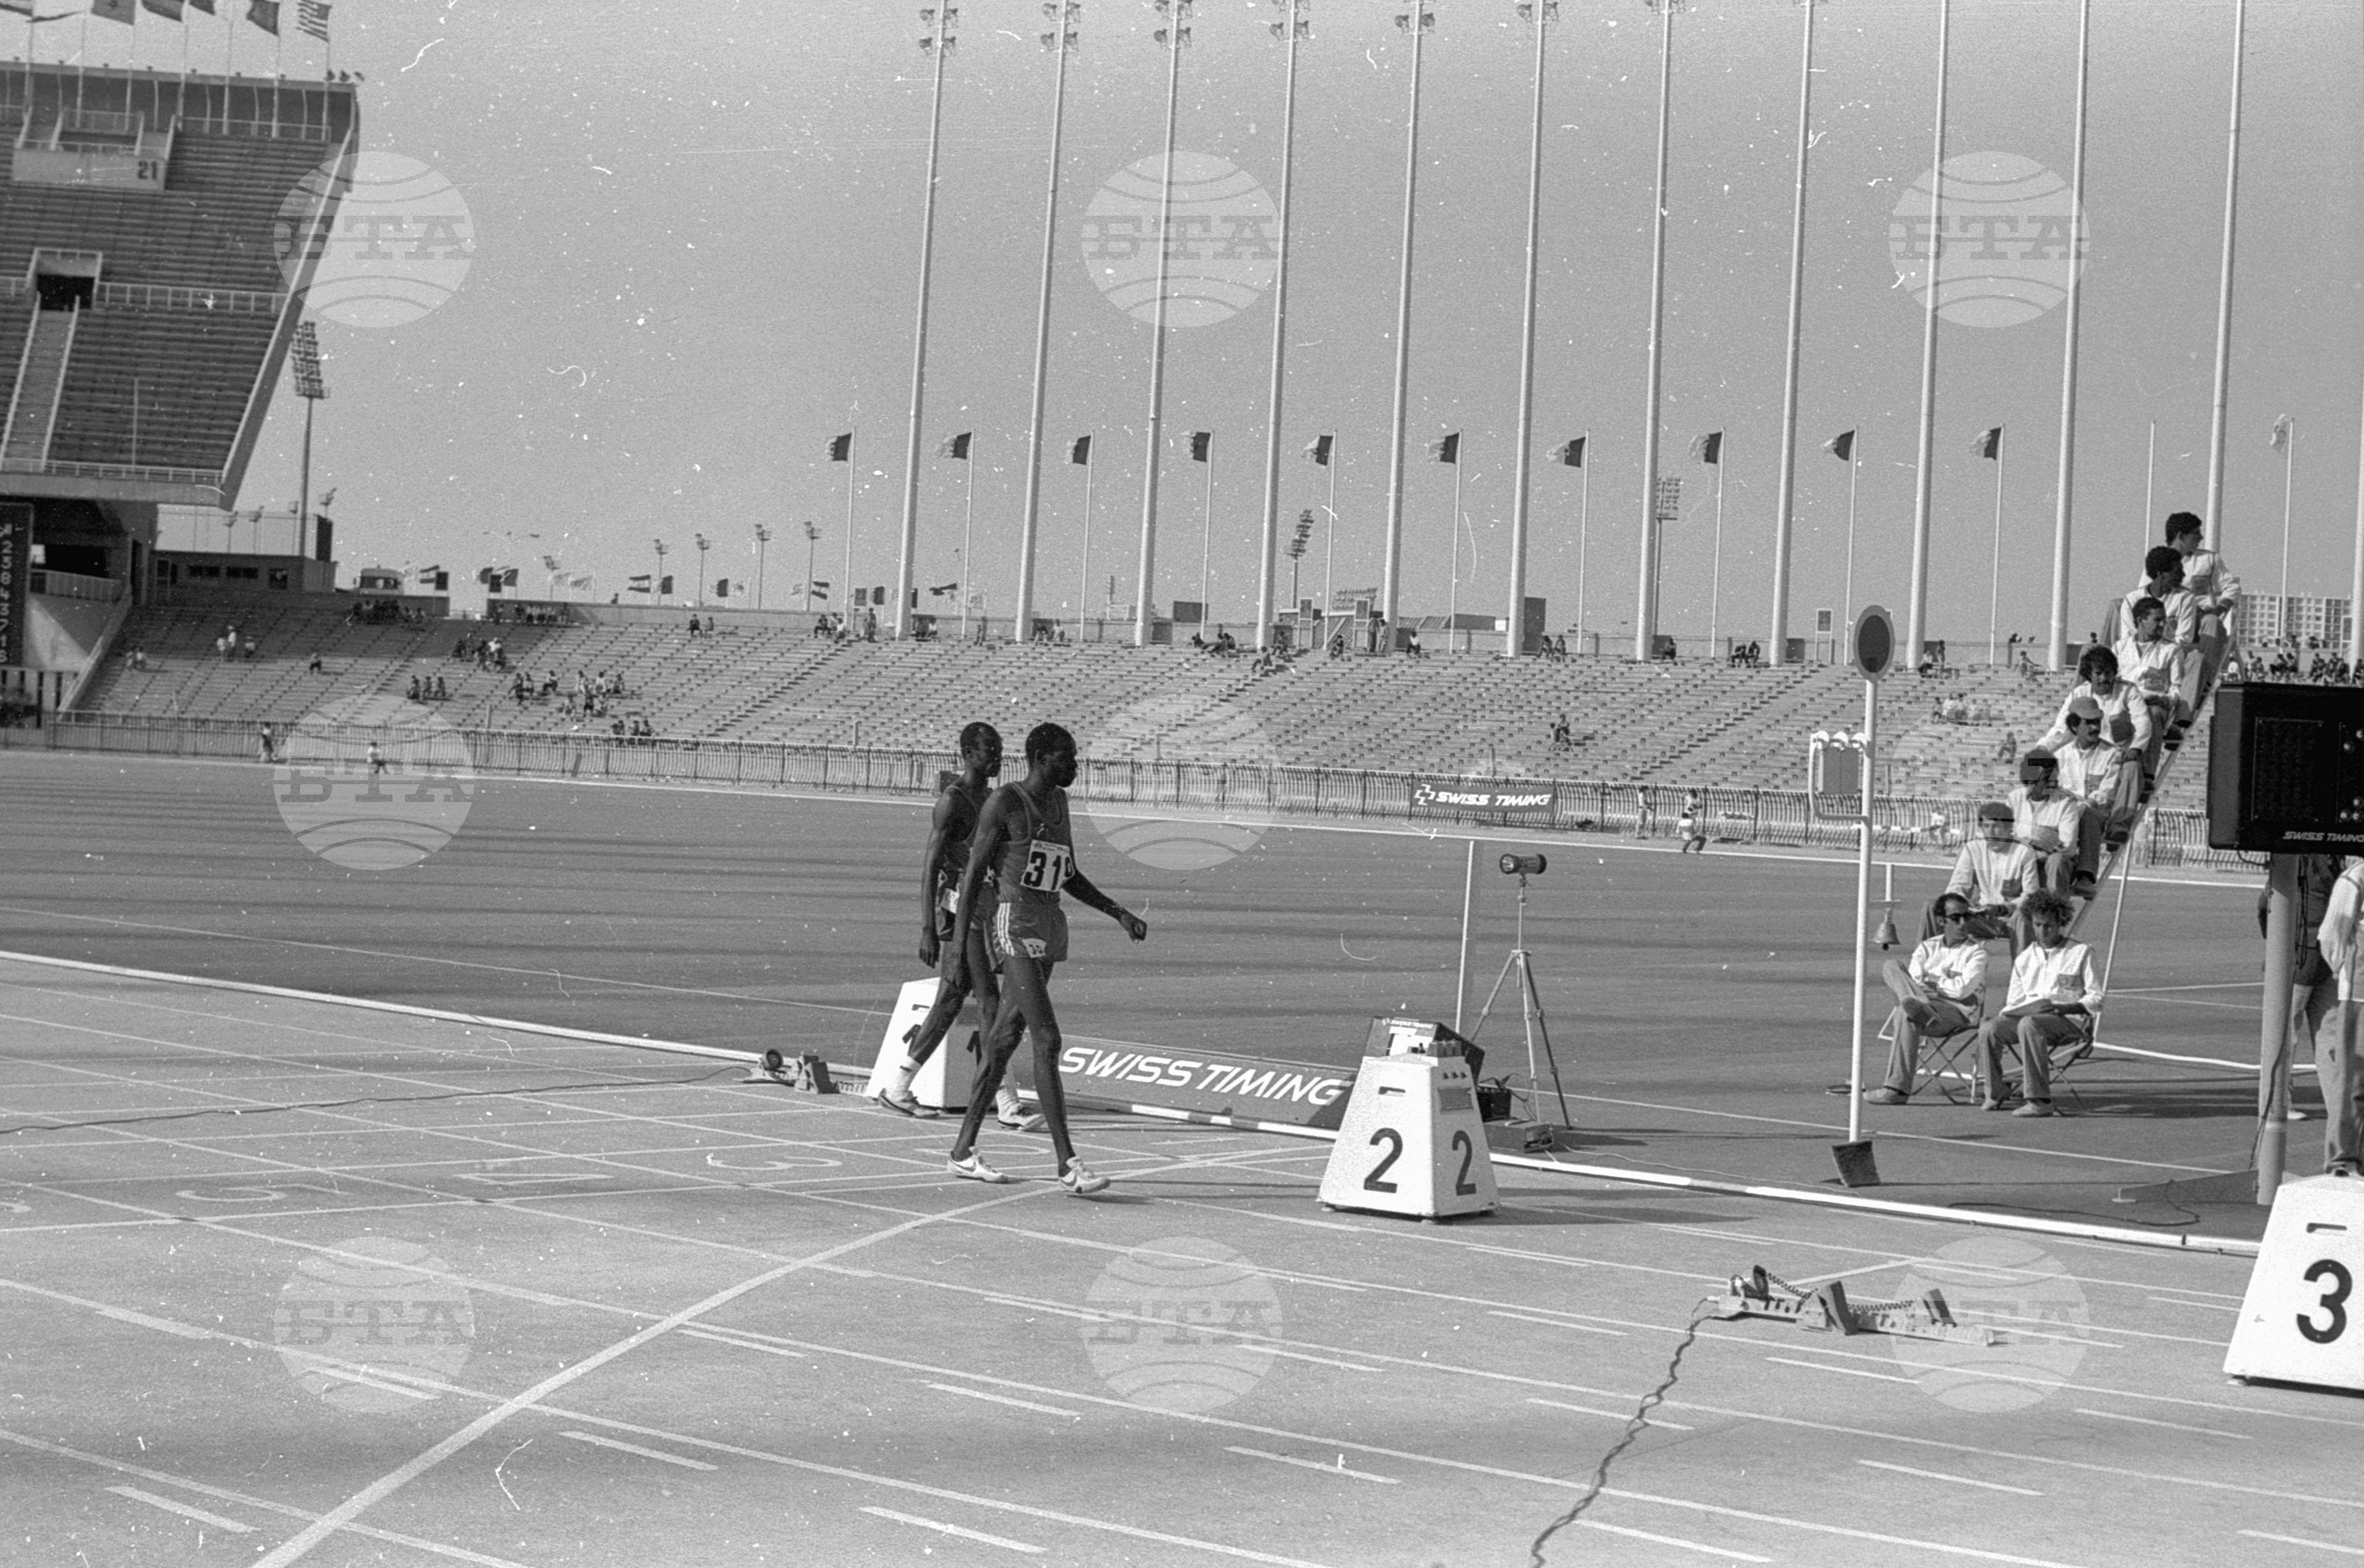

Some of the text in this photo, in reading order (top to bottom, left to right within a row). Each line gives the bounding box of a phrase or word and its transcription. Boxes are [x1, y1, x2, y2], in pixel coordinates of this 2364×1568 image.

[138, 160, 157, 180] 21
[1436, 791, 1553, 806] SWISS TIMING
[2282, 831, 2326, 841] SWISS
[1058, 1047, 1355, 1106] SWISS TIMING
[1363, 1127, 1403, 1194] 2
[1452, 1129, 1477, 1196] 2
[2296, 1259, 2353, 1344] 3
